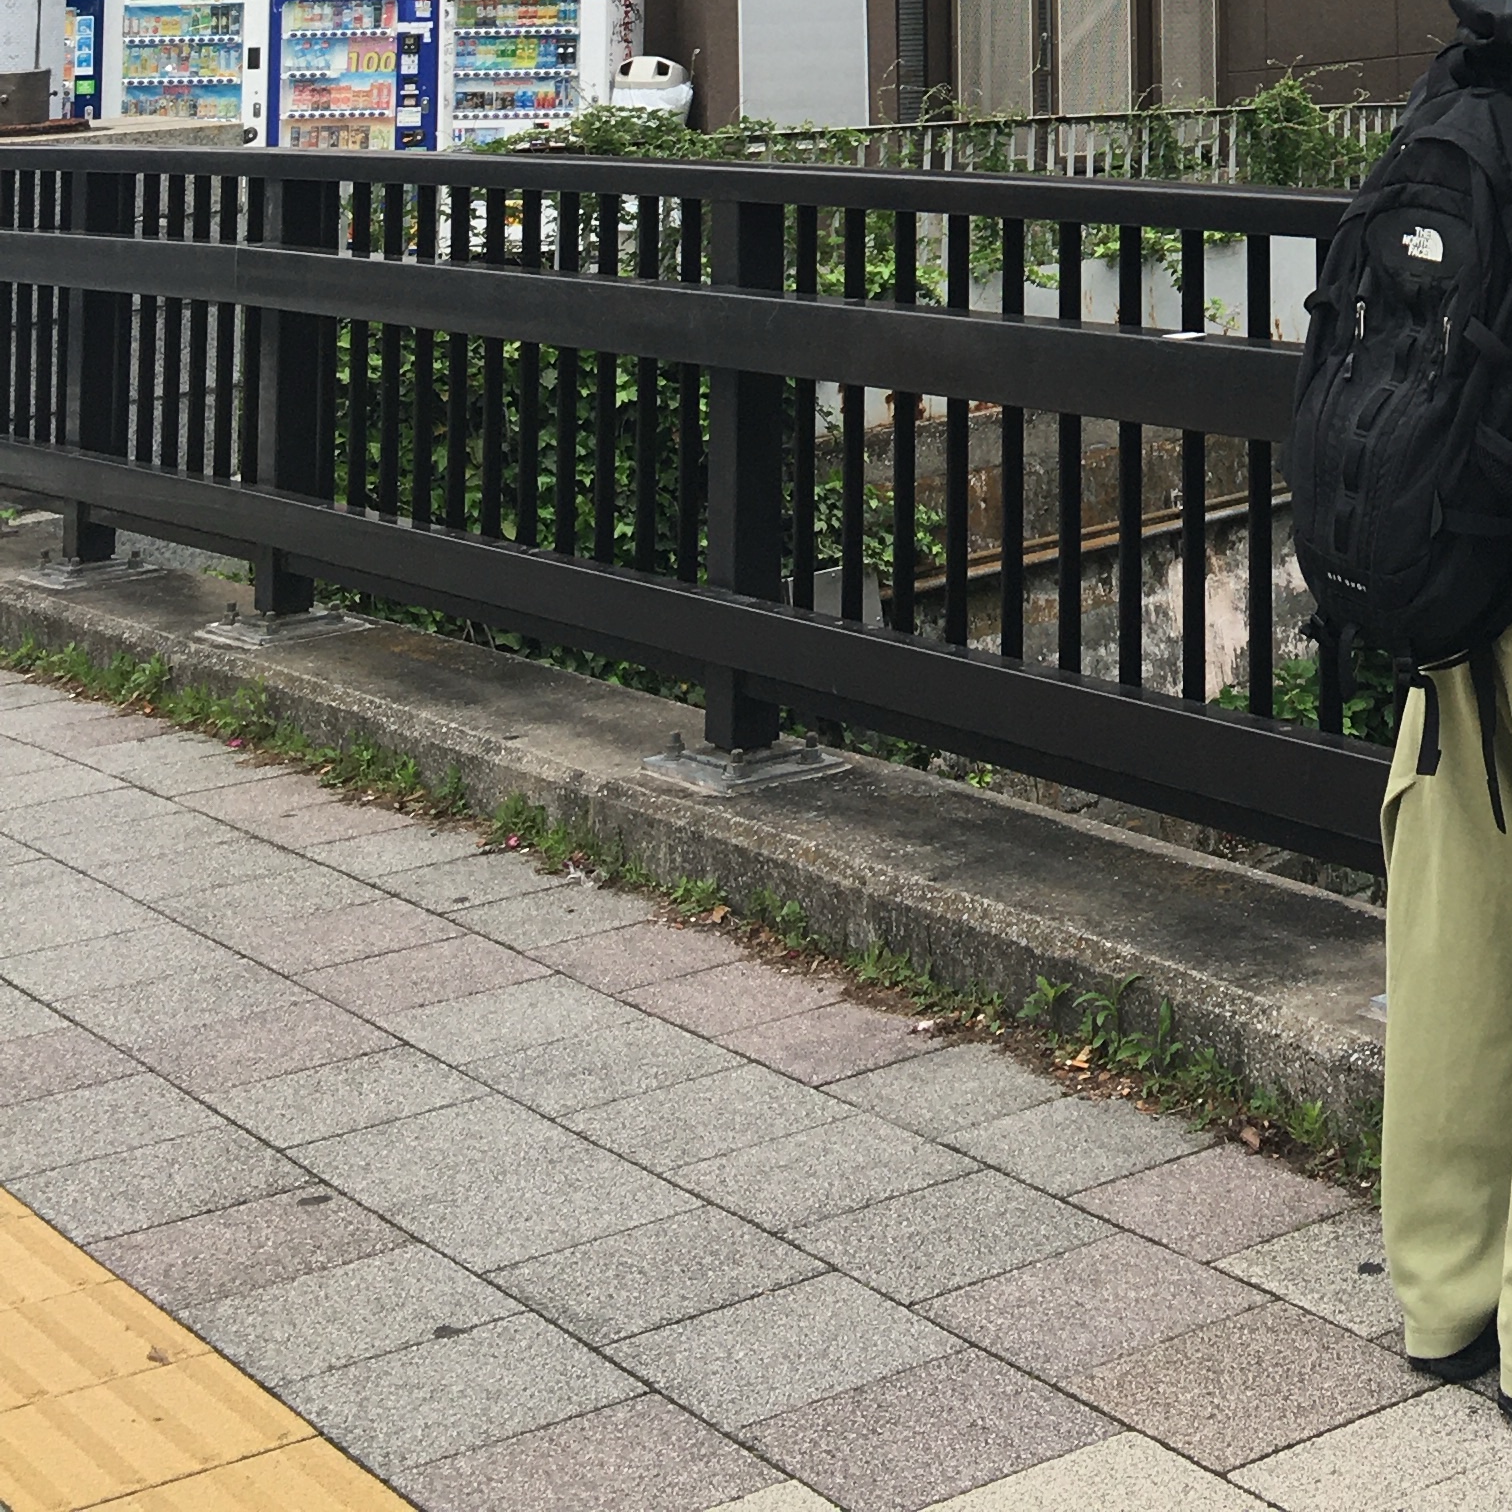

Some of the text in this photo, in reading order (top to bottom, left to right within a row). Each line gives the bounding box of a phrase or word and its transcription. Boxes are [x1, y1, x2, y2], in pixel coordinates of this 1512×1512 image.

[348, 51, 397, 73] 100
[1415, 226, 1432, 238] THE
[1402, 234, 1429, 249] NORTH
[1407, 245, 1429, 258] FACE
